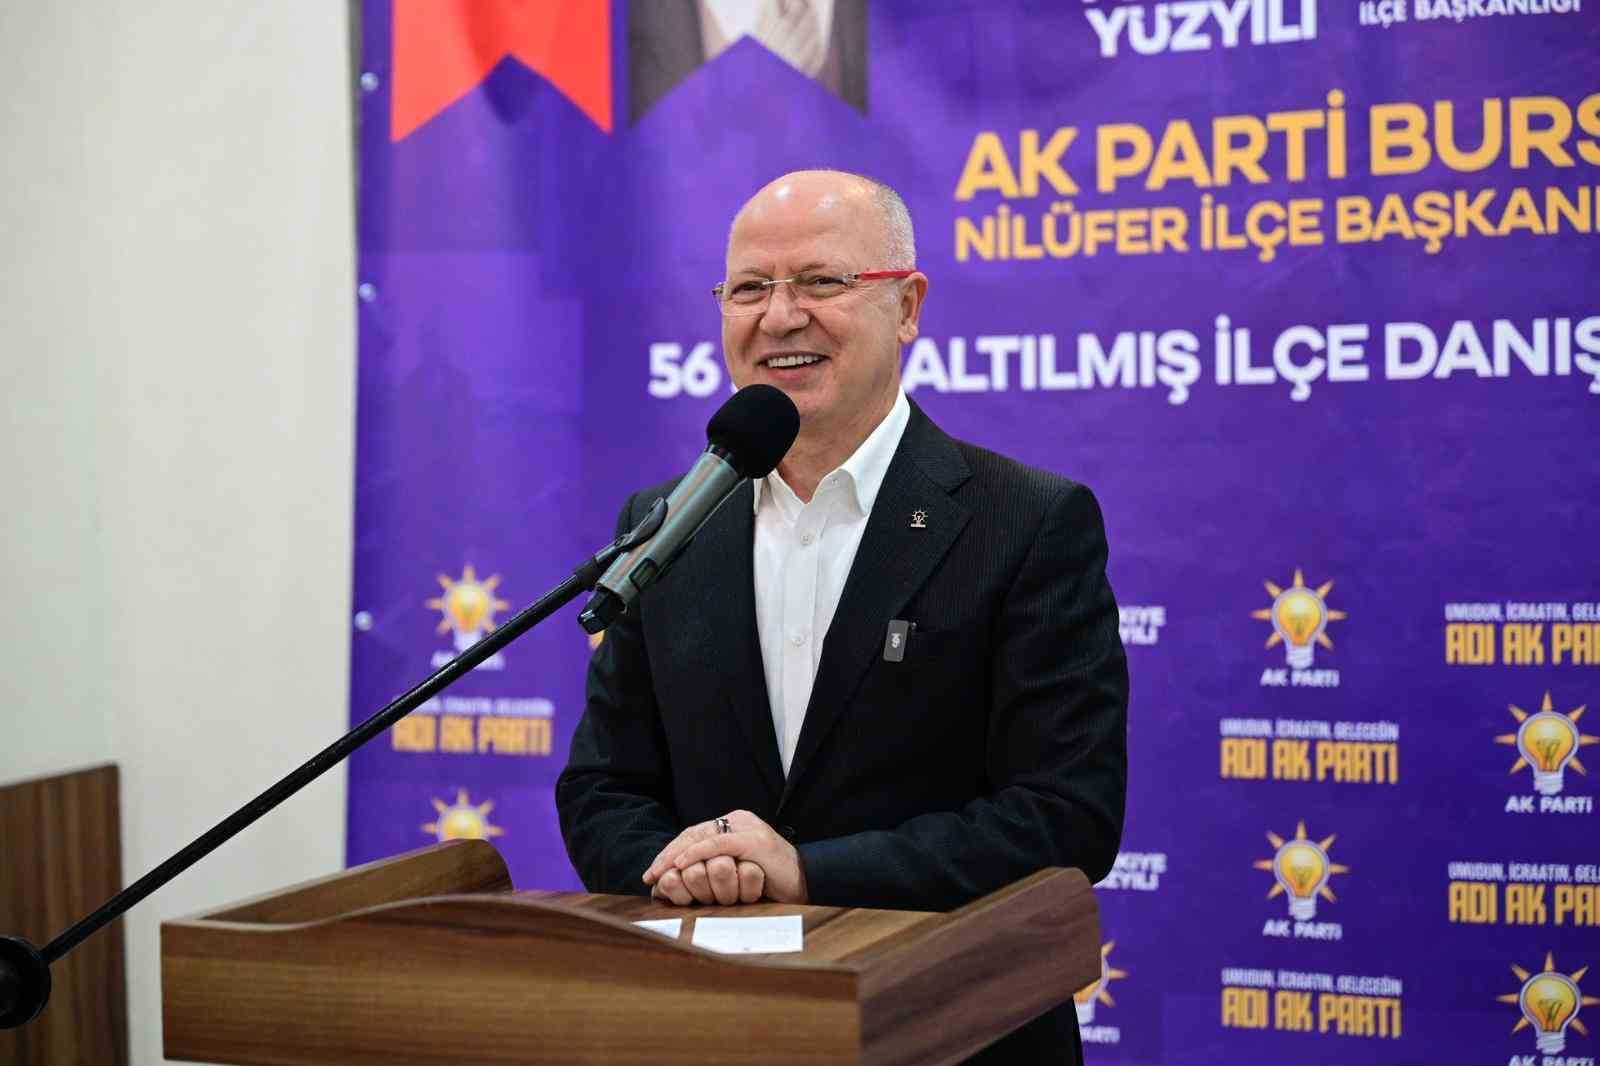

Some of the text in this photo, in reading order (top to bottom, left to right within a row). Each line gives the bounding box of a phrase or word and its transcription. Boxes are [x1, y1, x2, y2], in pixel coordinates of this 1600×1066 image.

[955, 127, 1080, 200] AK
[1097, 89, 1347, 193] PARTİ
[955, 186, 1600, 262] NİLÜFER İLÇE BAŞKAN
[648, 342, 722, 398] 56
[1215, 314, 1370, 401] İLÇE
[1445, 622, 1496, 666] ADI
[1502, 622, 1546, 666] AK
[1220, 737, 1267, 779] ADI
[1272, 738, 1311, 781] AK
[1504, 795, 1535, 814] AK
[1448, 880, 1498, 925] ADI
[1505, 882, 1548, 926] AK
[1221, 986, 1269, 1029] ADI
[1274, 989, 1314, 1033] AK
